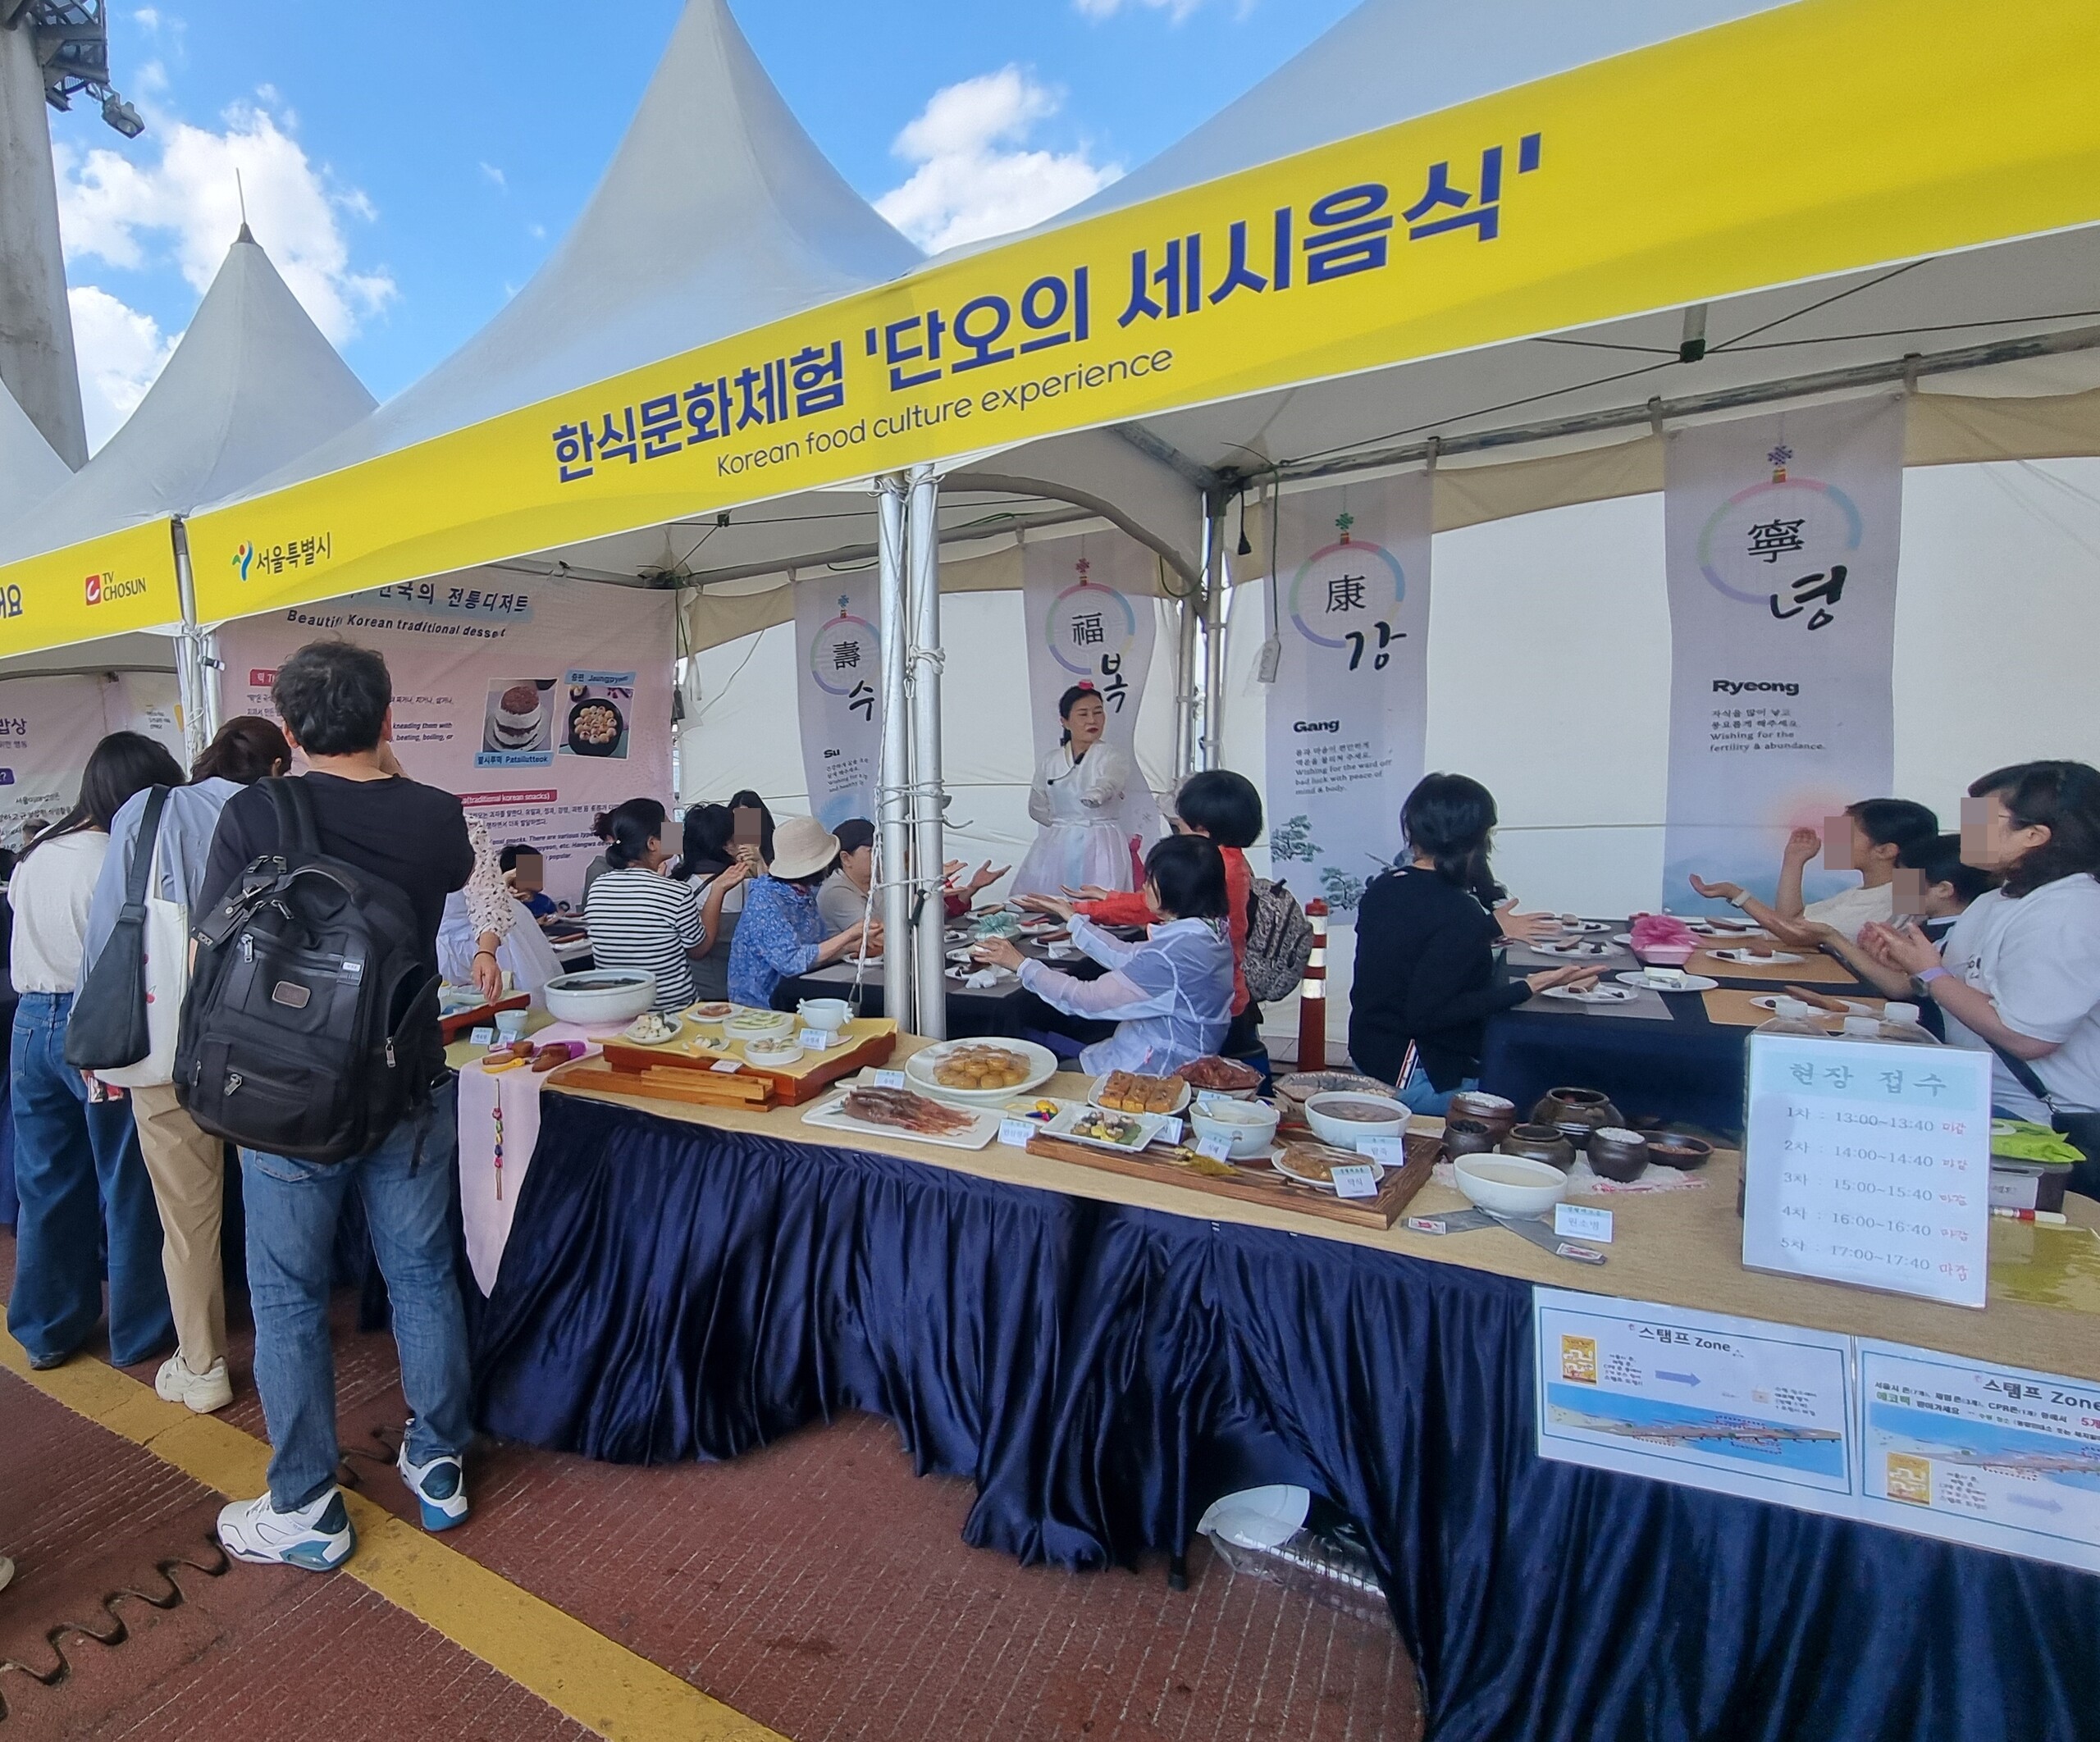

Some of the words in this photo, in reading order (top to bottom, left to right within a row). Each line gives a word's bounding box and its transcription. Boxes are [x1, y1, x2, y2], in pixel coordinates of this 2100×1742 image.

[552, 340, 845, 483] 한식문화체험
[865, 266, 1089, 393] '단오의
[1116, 131, 1543, 330] 세시음식'
[718, 444, 801, 477] Korean
[806, 419, 867, 458] food
[873, 399, 972, 439] culture
[981, 348, 1173, 415] experience
[256, 531, 331, 575] 서울특별시
[103, 571, 114, 585] TV
[103, 577, 147, 602] CHOSUN
[448, 586, 529, 613] 전통디저트
[1326, 574, 1367, 613] 康
[347, 613, 393, 630] Korean
[397, 618, 461, 636] traditional
[1071, 612, 1104, 646] 福
[833, 641, 861, 671] 壽
[1345, 621, 1407, 672] 강
[849, 679, 875, 721] 수
[1712, 679, 1800, 696] Ryeong
[1293, 720, 1340, 733] Gang
[1710, 732, 1754, 741] Wishing
[824, 749, 840, 759] Su
[1710, 744, 1750, 752] fertility
[1330, 774, 1347, 782] with
[1789, 1061, 1855, 1090] 현장
[1878, 1069, 1947, 1097] 접수
[1787, 1106, 1810, 1121] 1차
[1836, 1110, 1934, 1133] 13:00~13:40
[1784, 1140, 1809, 1155] 2차
[1834, 1145, 1934, 1168] 14:00~14:40
[1783, 1172, 1809, 1187] 3차
[1833, 1179, 1933, 1202] 15:00~15:40
[1782, 1205, 1806, 1220] 4차
[1832, 1211, 1932, 1237] 16:00~16:40
[1780, 1238, 1806, 1252] 5차
[1830, 1245, 1930, 1270] 17:00~17:40
[1638, 1325, 1691, 1347] 스탬프
[1694, 1336, 1731, 1352] Zone
[1983, 1379, 2043, 1399] 스탬프
[2051, 1390, 2100, 1411] Zone
